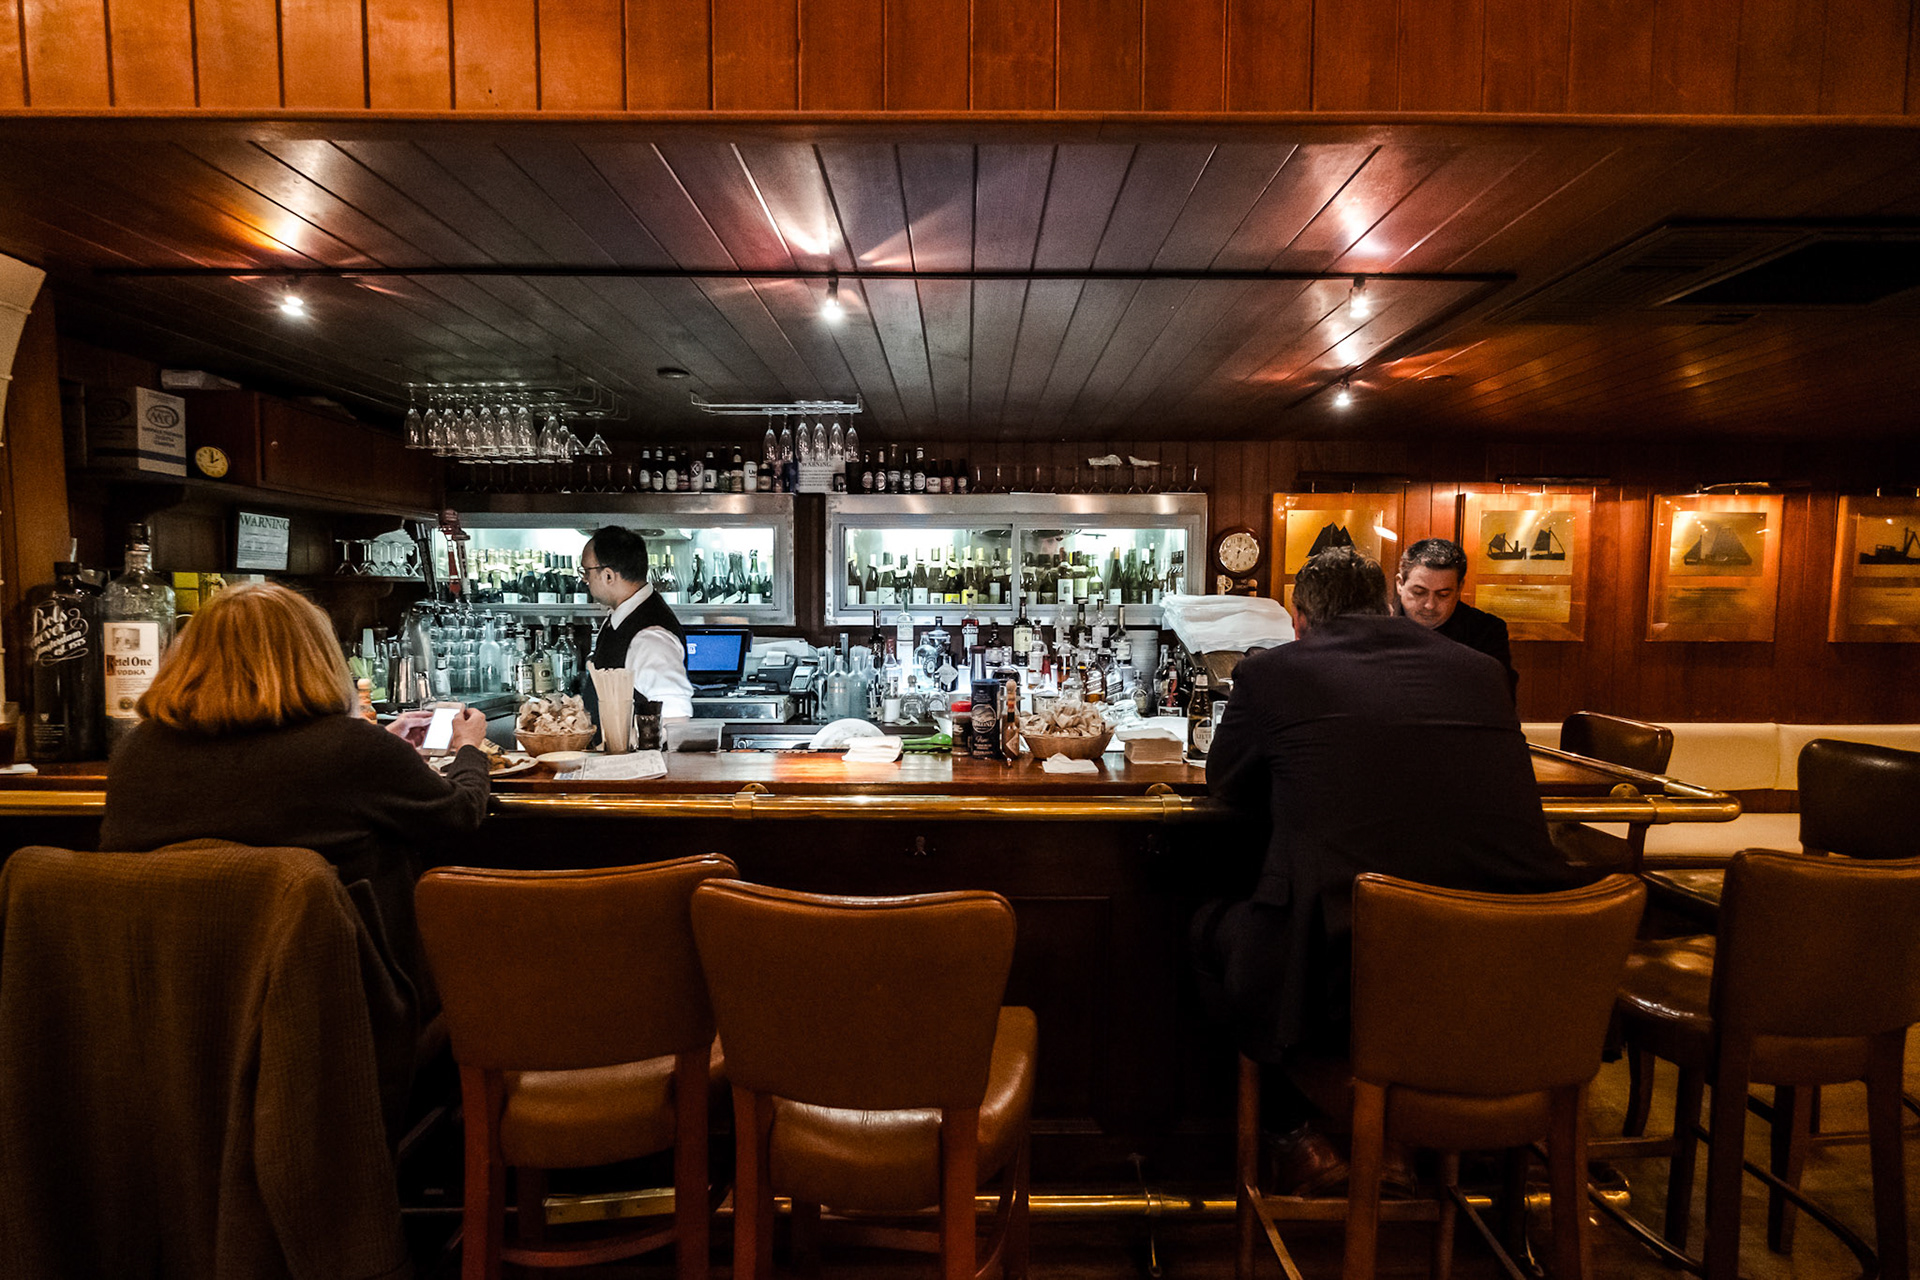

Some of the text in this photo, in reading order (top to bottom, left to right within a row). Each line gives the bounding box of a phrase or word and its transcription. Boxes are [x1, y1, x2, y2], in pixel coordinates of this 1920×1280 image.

[240, 514, 289, 530] WARNING
[32, 601, 68, 636] Bols
[131, 656, 152, 667] One
